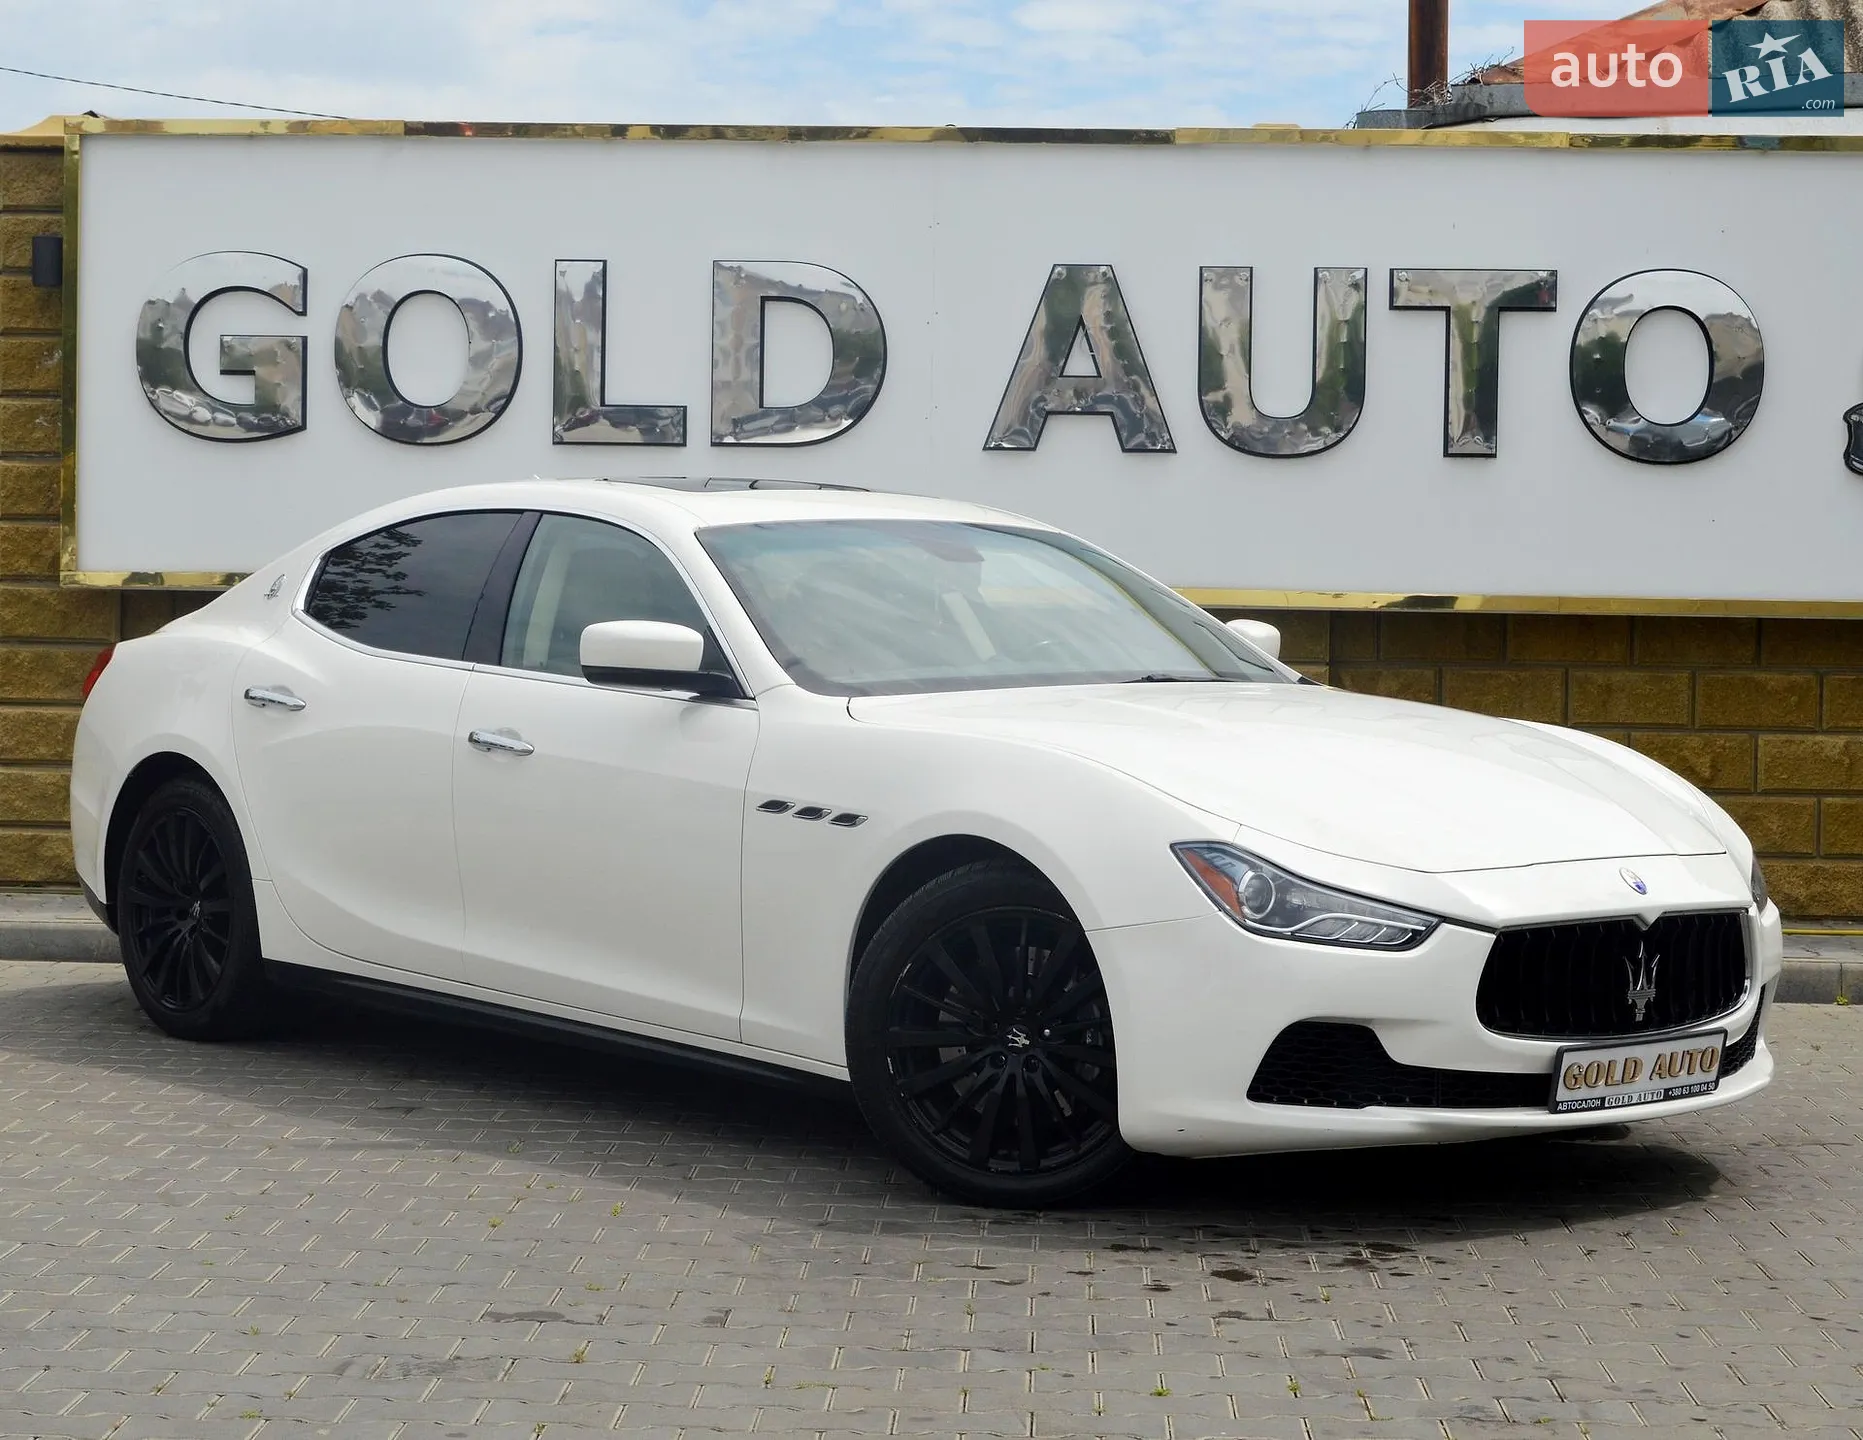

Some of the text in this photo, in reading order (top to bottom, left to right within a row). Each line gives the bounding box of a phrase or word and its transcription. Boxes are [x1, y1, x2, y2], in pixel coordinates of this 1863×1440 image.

[136, 250, 1766, 466] GOLD AUTO
[1563, 1045, 1720, 1090] GOLD AUTO
[1557, 1099, 1601, 1111] АВТОСАЛОН
[1607, 1094, 1634, 1106] GOLD
[1635, 1089, 1663, 1102] AUTO
[1669, 1087, 1682, 1097] +380
